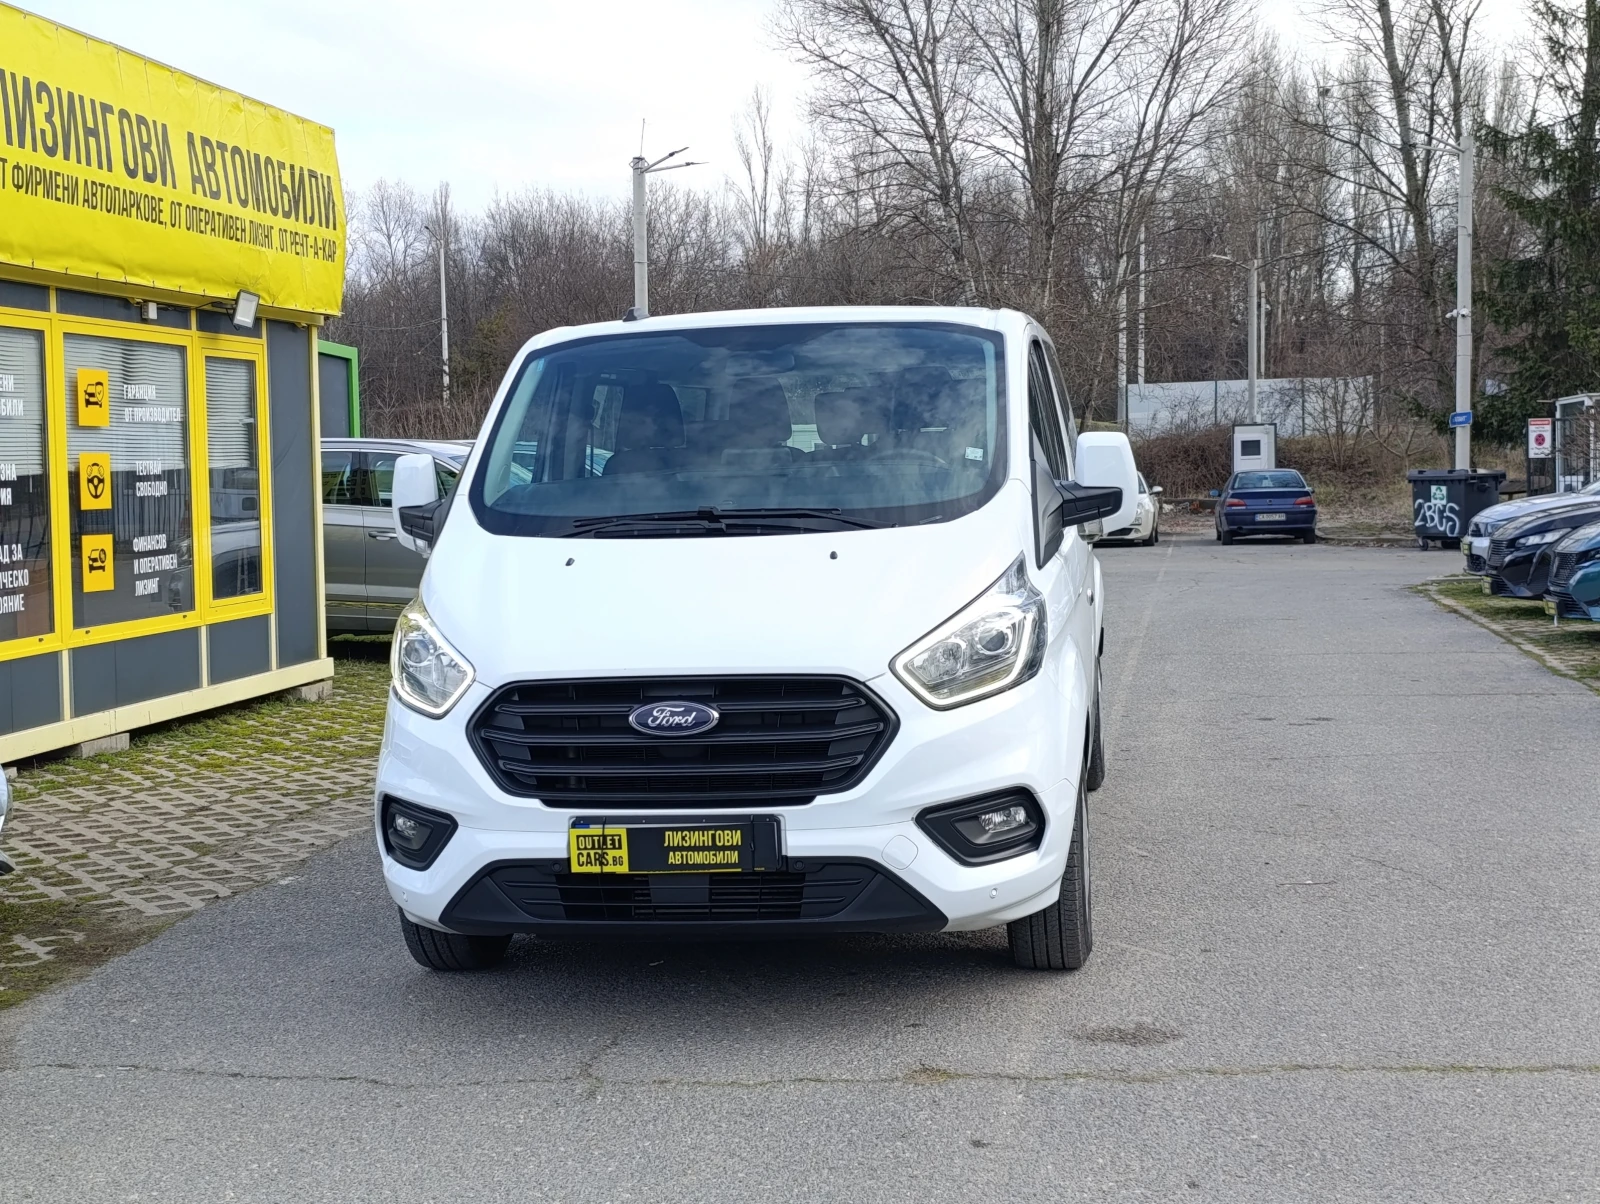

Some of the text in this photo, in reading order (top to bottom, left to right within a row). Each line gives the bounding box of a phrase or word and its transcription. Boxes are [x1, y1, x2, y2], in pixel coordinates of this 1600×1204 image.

[187, 131, 337, 231] АВТОМОБИЛИ
[11, 161, 79, 207] ФИРМЕНИ
[82, 178, 168, 230] АВТОПАРКОВЕ,
[170, 200, 183, 229] ОТ
[185, 204, 247, 244] ОПЕРАТИВЕН
[278, 227, 289, 253] ОТ
[290, 230, 337, 263] РЕНТ-А-КАР
[123, 384, 157, 402] ГАРАНЦИЯ
[125, 407, 133, 422] ОТ
[136, 458, 162, 476] ТЕСТВАЙ
[136, 481, 168, 498] СВОБОДНО
[133, 533, 167, 553] ФИНАНСОВ
[12, 543, 24, 562] ЗА
[134, 553, 178, 575] И ОПЕРАТИВЕН
[135, 577, 160, 597] ЛИЗИНГ
[647, 706, 697, 727] Ford
[578, 836, 620, 849] OUTLET
[664, 830, 742, 847] ЛИЗИНГОВИ
[668, 850, 739, 865] АВТОМОБИЛИ
